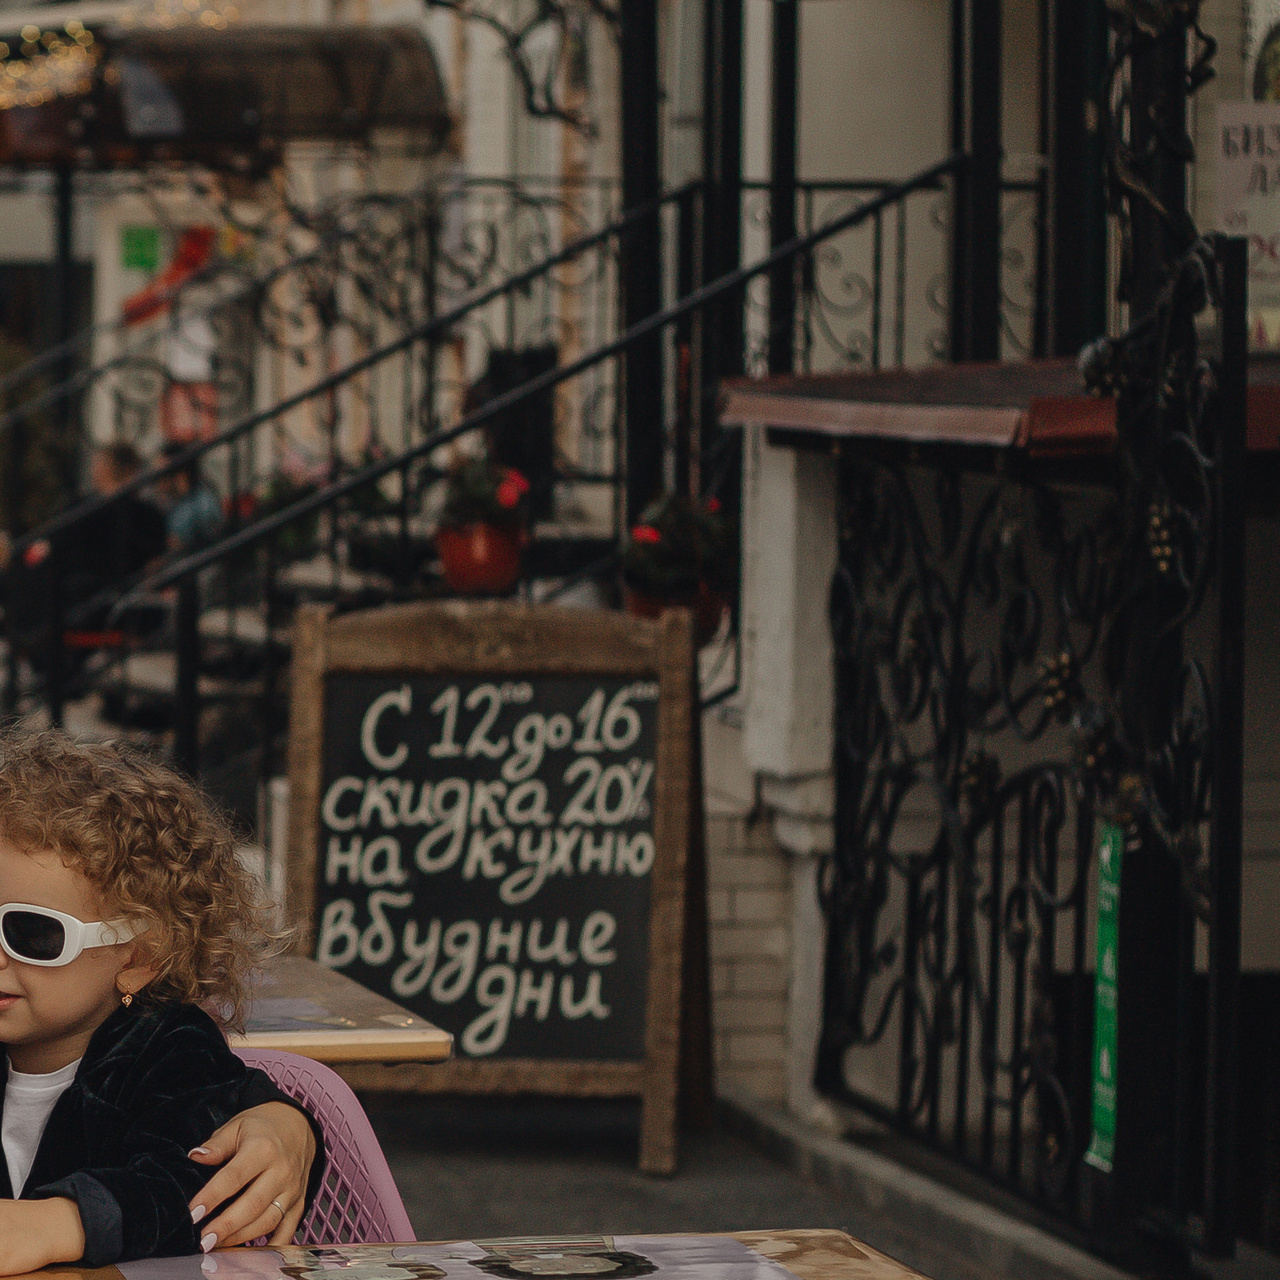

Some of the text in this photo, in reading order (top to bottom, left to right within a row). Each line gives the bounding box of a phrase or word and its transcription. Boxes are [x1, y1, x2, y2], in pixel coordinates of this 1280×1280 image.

[501, 711, 573, 783] до
[322, 754, 656, 875] скидка 20%
[326, 824, 656, 905] на кухню
[461, 963, 612, 1057] дни
